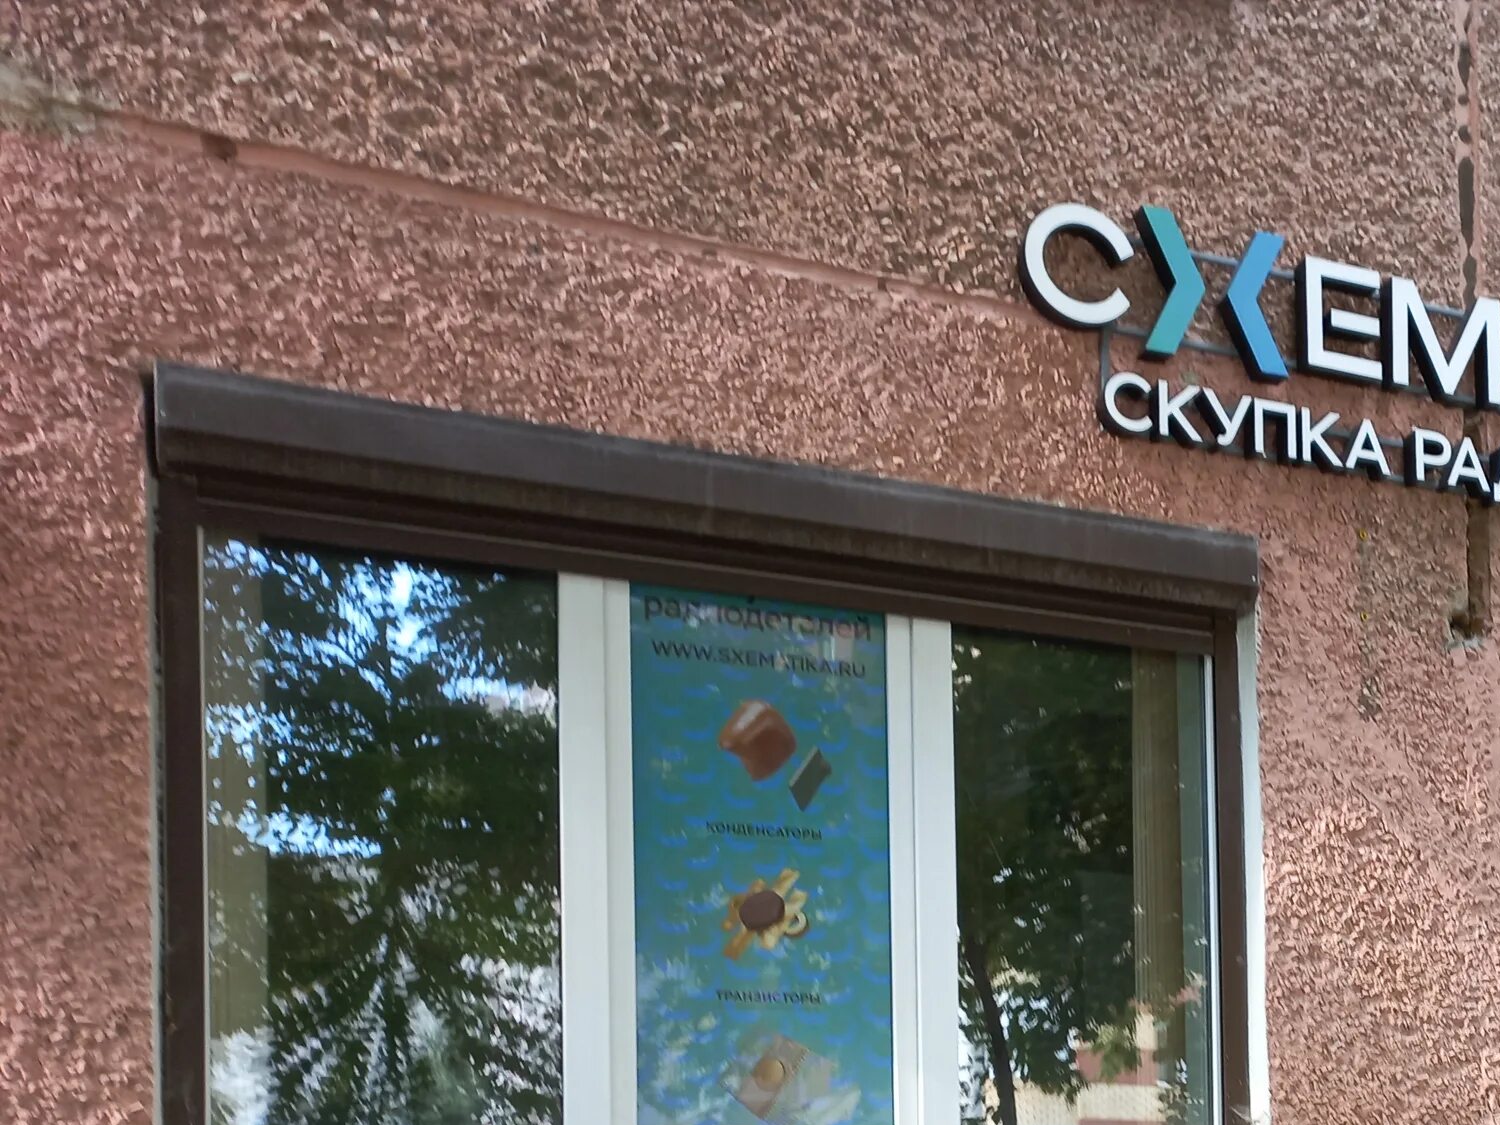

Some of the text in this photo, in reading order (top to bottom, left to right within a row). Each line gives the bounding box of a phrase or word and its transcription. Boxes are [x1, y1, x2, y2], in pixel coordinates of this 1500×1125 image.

[1102, 371, 1391, 478] СКУПКА
[705, 820, 823, 842] КОНДЕНСАТОРЫ
[715, 988, 822, 1006] ТРАНЗИСТОРЫ
